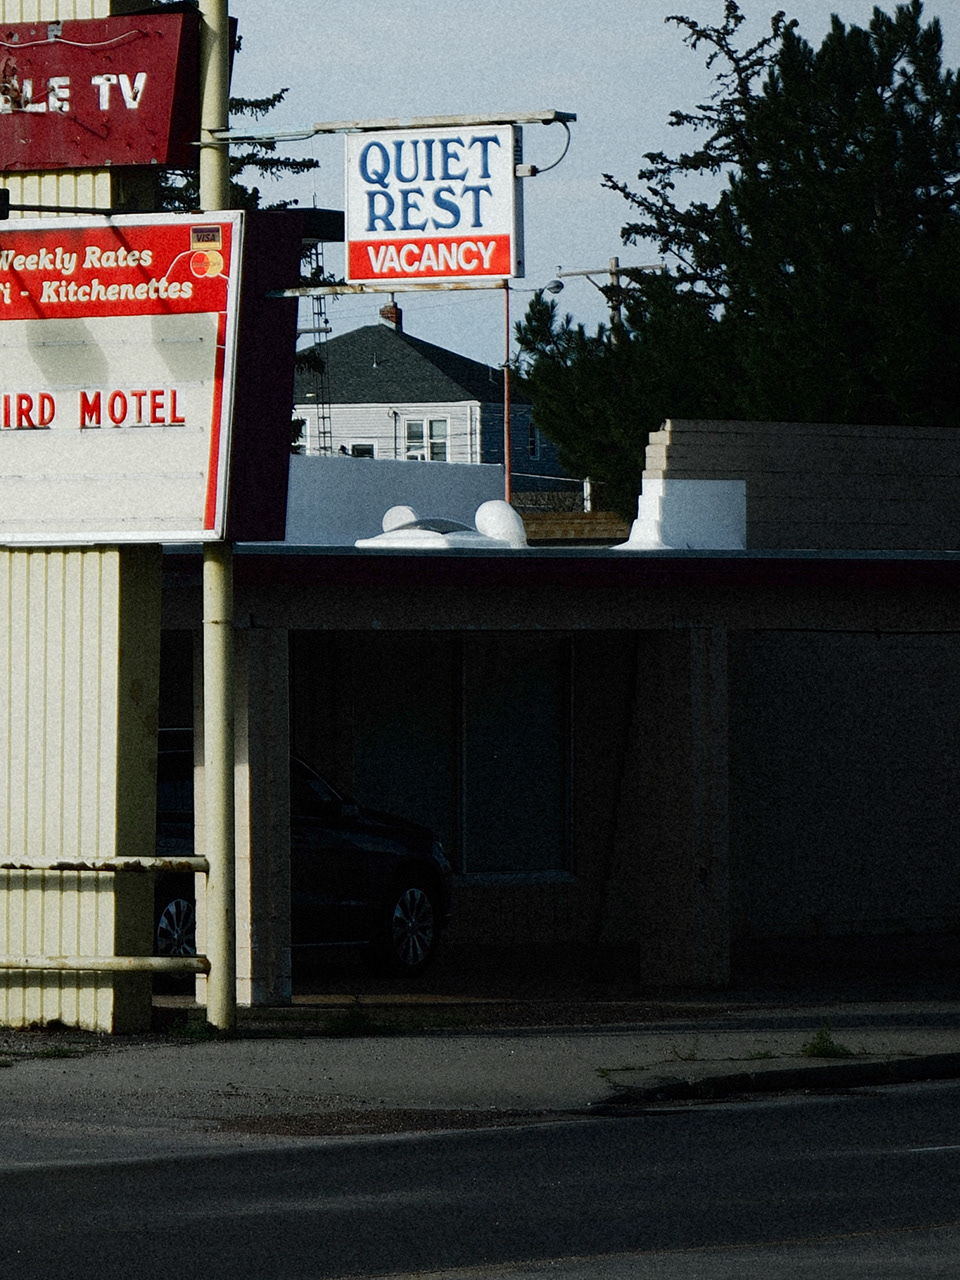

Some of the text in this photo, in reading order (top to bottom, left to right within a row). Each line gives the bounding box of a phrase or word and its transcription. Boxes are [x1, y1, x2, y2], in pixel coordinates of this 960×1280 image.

[91, 72, 147, 111] TV
[358, 134, 501, 188] QUIET
[365, 183, 493, 232] REST
[196, 233, 216, 242] VISA
[82, 245, 153, 269] Rates
[366, 240, 496, 273] VACANCY
[40, 277, 193, 303] Kitchenettes
[79, 389, 186, 430] MOTEL
